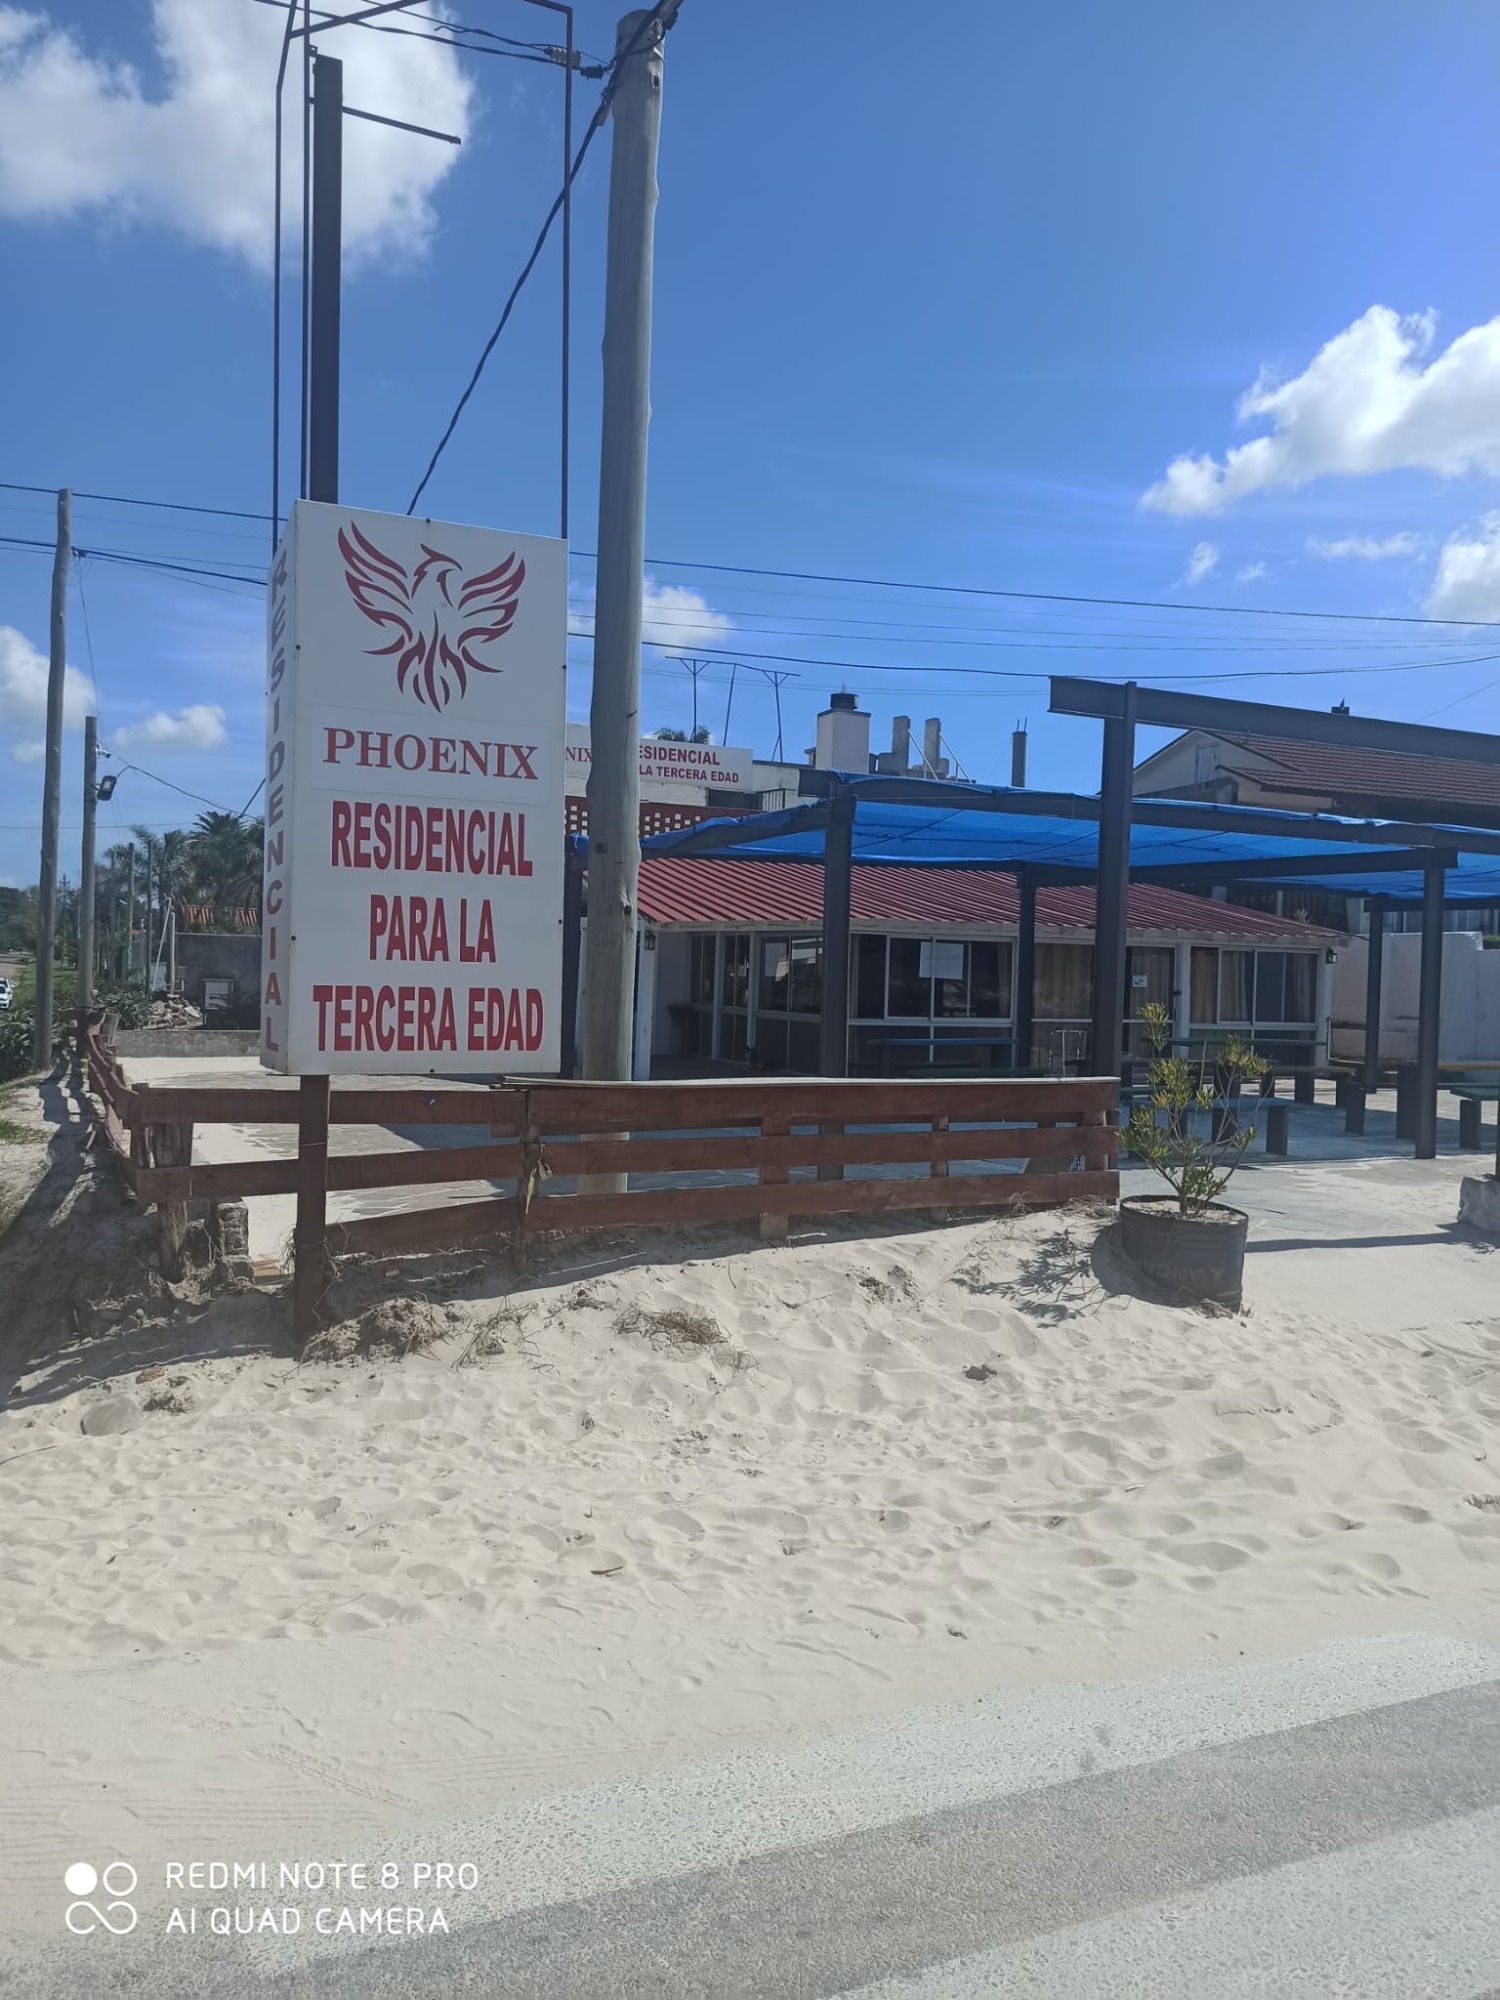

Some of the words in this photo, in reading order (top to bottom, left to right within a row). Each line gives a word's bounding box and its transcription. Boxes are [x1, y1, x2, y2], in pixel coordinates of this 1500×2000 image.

[322, 726, 538, 780] PHOENIX
[639, 744, 721, 766] SIDENCIAL
[656, 765, 708, 781] TERCERA
[710, 770, 739, 783] EDAD
[264, 549, 288, 1053] RESIDENCIAL
[331, 801, 533, 877] RESIDENCIAL
[369, 894, 448, 962] PARA
[459, 898, 497, 963] LA
[312, 984, 458, 1052] TERCERA
[466, 986, 544, 1052] EDAD
